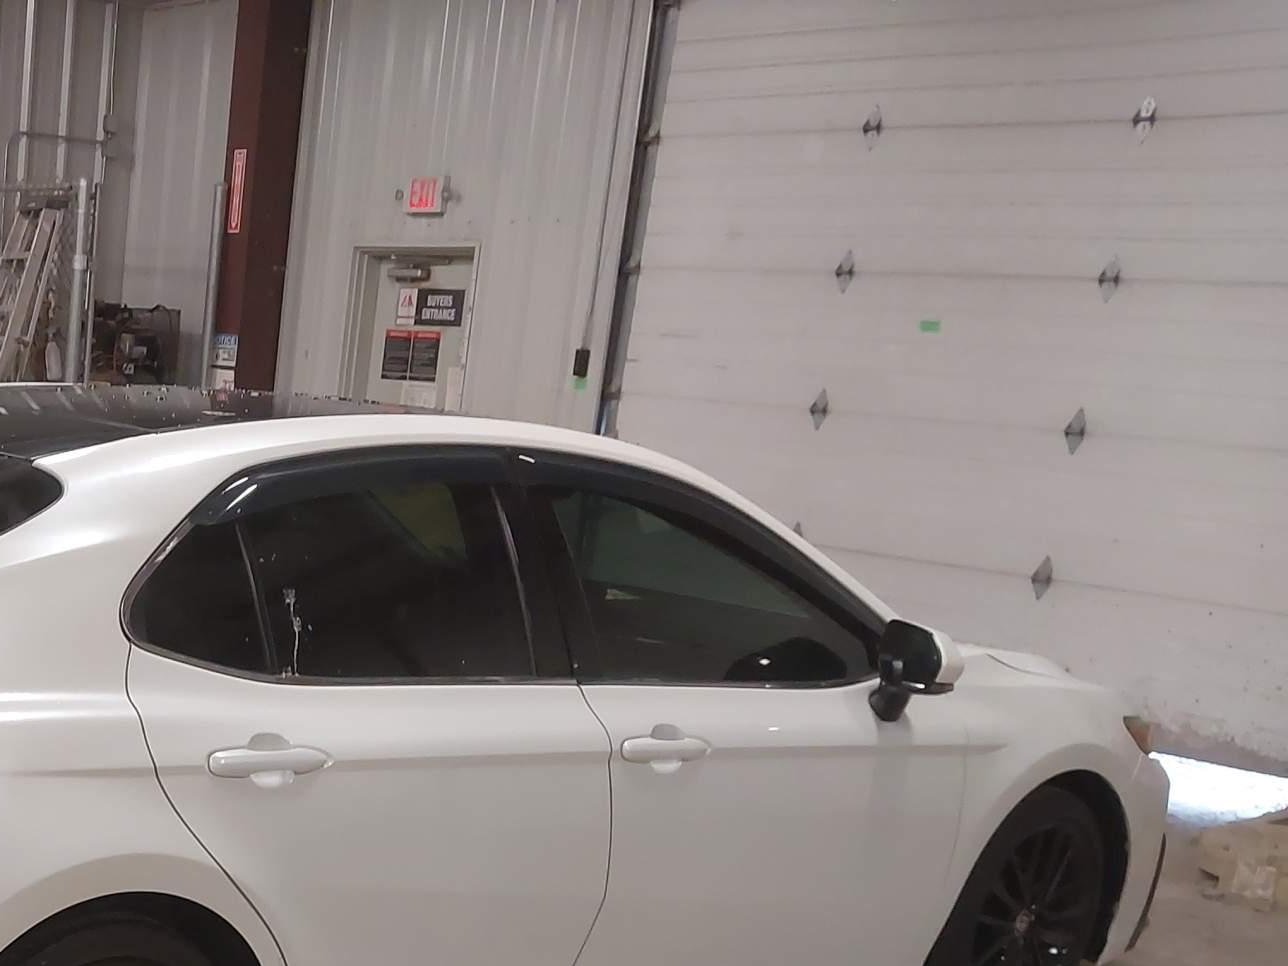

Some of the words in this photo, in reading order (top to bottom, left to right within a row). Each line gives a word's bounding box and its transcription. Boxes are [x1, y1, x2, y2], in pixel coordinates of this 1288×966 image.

[409, 177, 436, 208] EXIT
[427, 294, 454, 307] BUYERS
[421, 307, 456, 321] ENTRANCE
